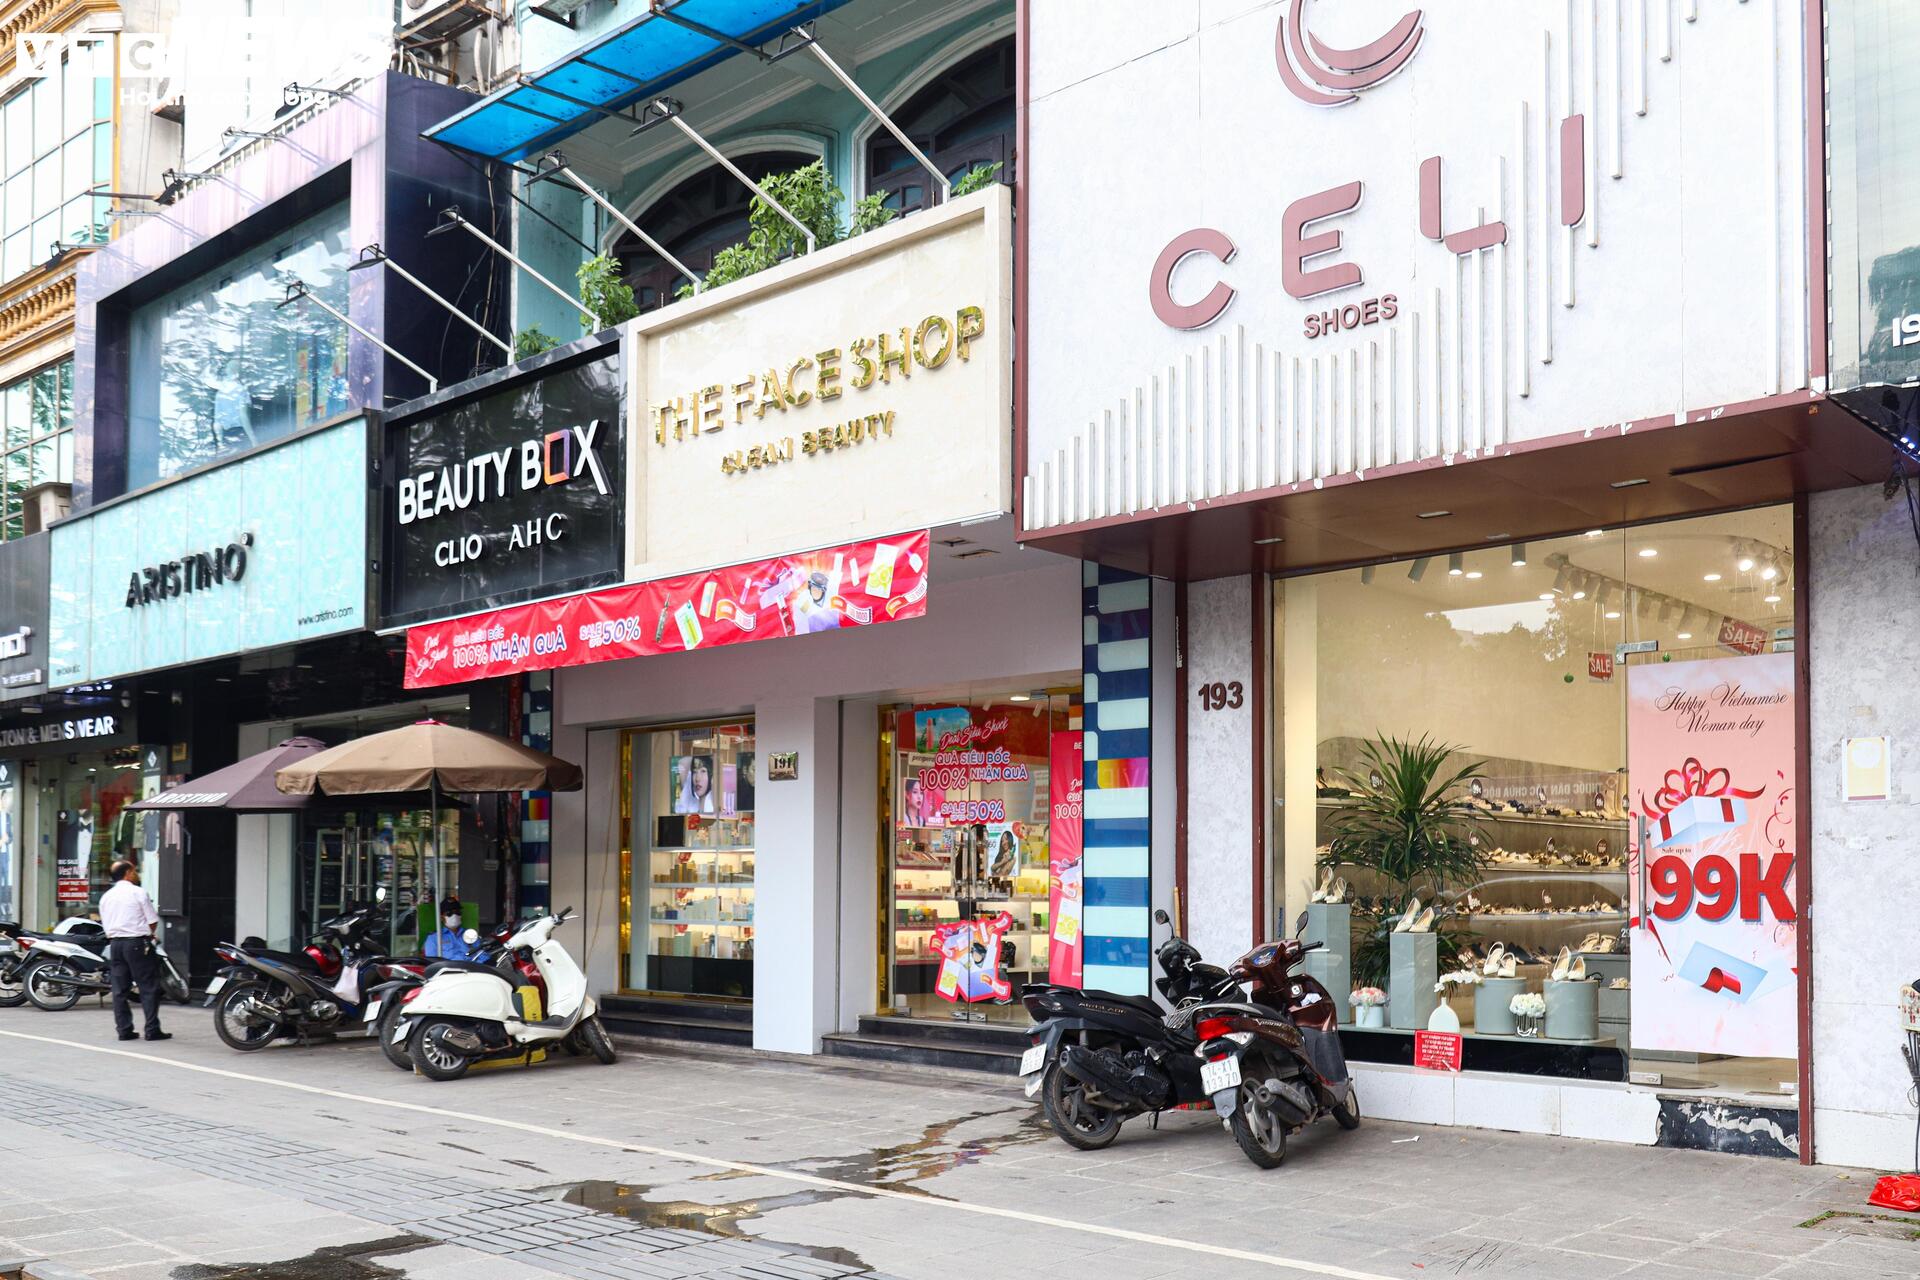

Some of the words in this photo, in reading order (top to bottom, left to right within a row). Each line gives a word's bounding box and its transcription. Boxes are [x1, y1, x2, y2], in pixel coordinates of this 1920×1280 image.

[1303, 293, 1398, 339] SHOES
[650, 384, 723, 447] THE
[731, 348, 843, 425] FACE
[850, 305, 985, 390] SHOP
[802, 410, 896, 455] BEAUTY
[399, 446, 513, 525] BEAUTY
[521, 419, 608, 496] BOX
[434, 533, 483, 567] CLIO
[508, 512, 563, 551] AHC
[126, 541, 248, 608] ARISTINO
[579, 622, 602, 640] SALE
[602, 615, 641, 645] 50%
[1724, 624, 1764, 651] SALE
[452, 644, 489, 669] 100%
[490, 632, 530, 664] NHẬN
[533, 624, 567, 655] QUÀ
[1590, 656, 1611, 674] SALE
[1198, 681, 1243, 711] 193
[1655, 686, 1706, 716] Happy
[1711, 681, 1788, 708] Vietnamese
[1676, 708, 1736, 733] Woman
[1739, 714, 1765, 738] day
[774, 757, 791, 769] 191
[935, 752, 959, 766] QUÀ
[960, 750, 985, 764] SIÊU
[986, 747, 1010, 764] BỐC
[919, 768, 968, 790] 100%
[970, 765, 1000, 783] NHẬN
[1003, 764, 1028, 780] QUÀ
[941, 802, 966, 814] SALE
[967, 800, 1004, 820] 50%
[1650, 852, 1798, 922] 99K
